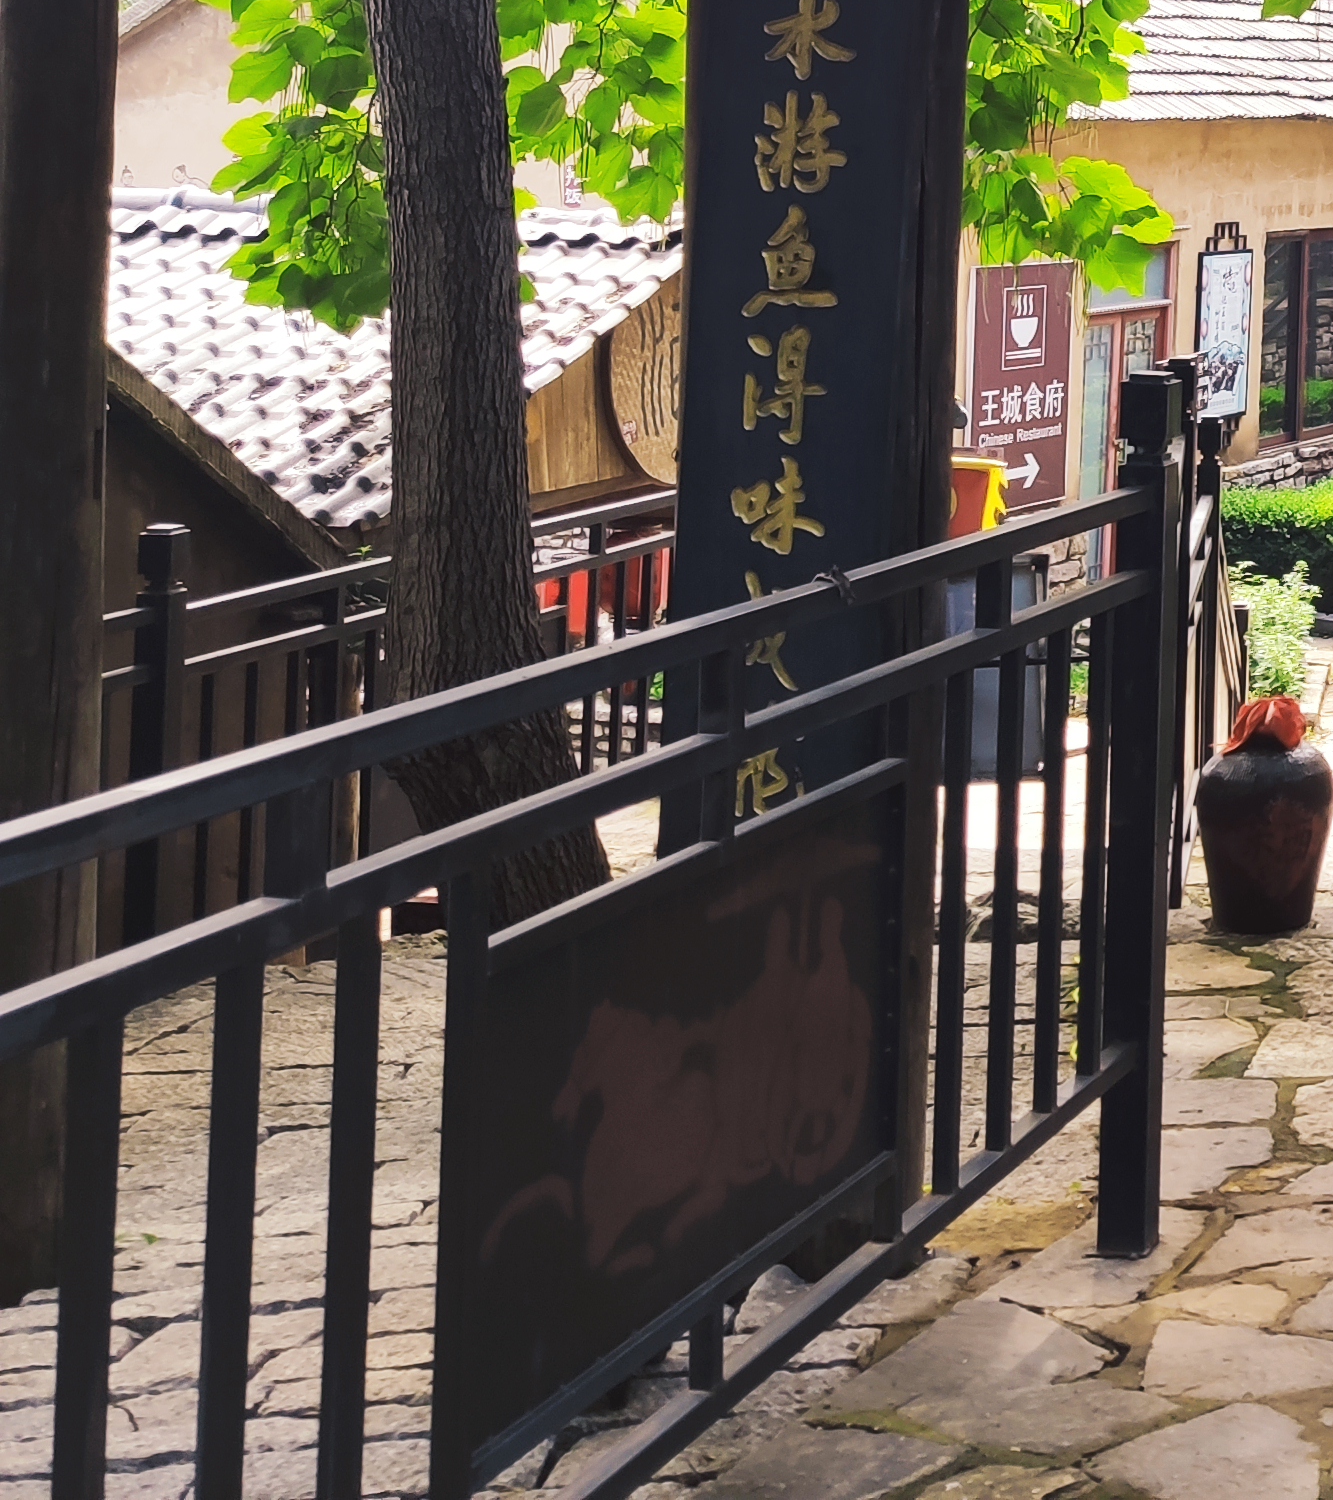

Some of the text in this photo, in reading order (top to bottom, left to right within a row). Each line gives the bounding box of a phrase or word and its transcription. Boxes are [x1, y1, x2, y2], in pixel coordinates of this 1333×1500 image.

[978, 378, 1065, 427] 王城食府
[978, 421, 1063, 449] Chinese Restaurant
